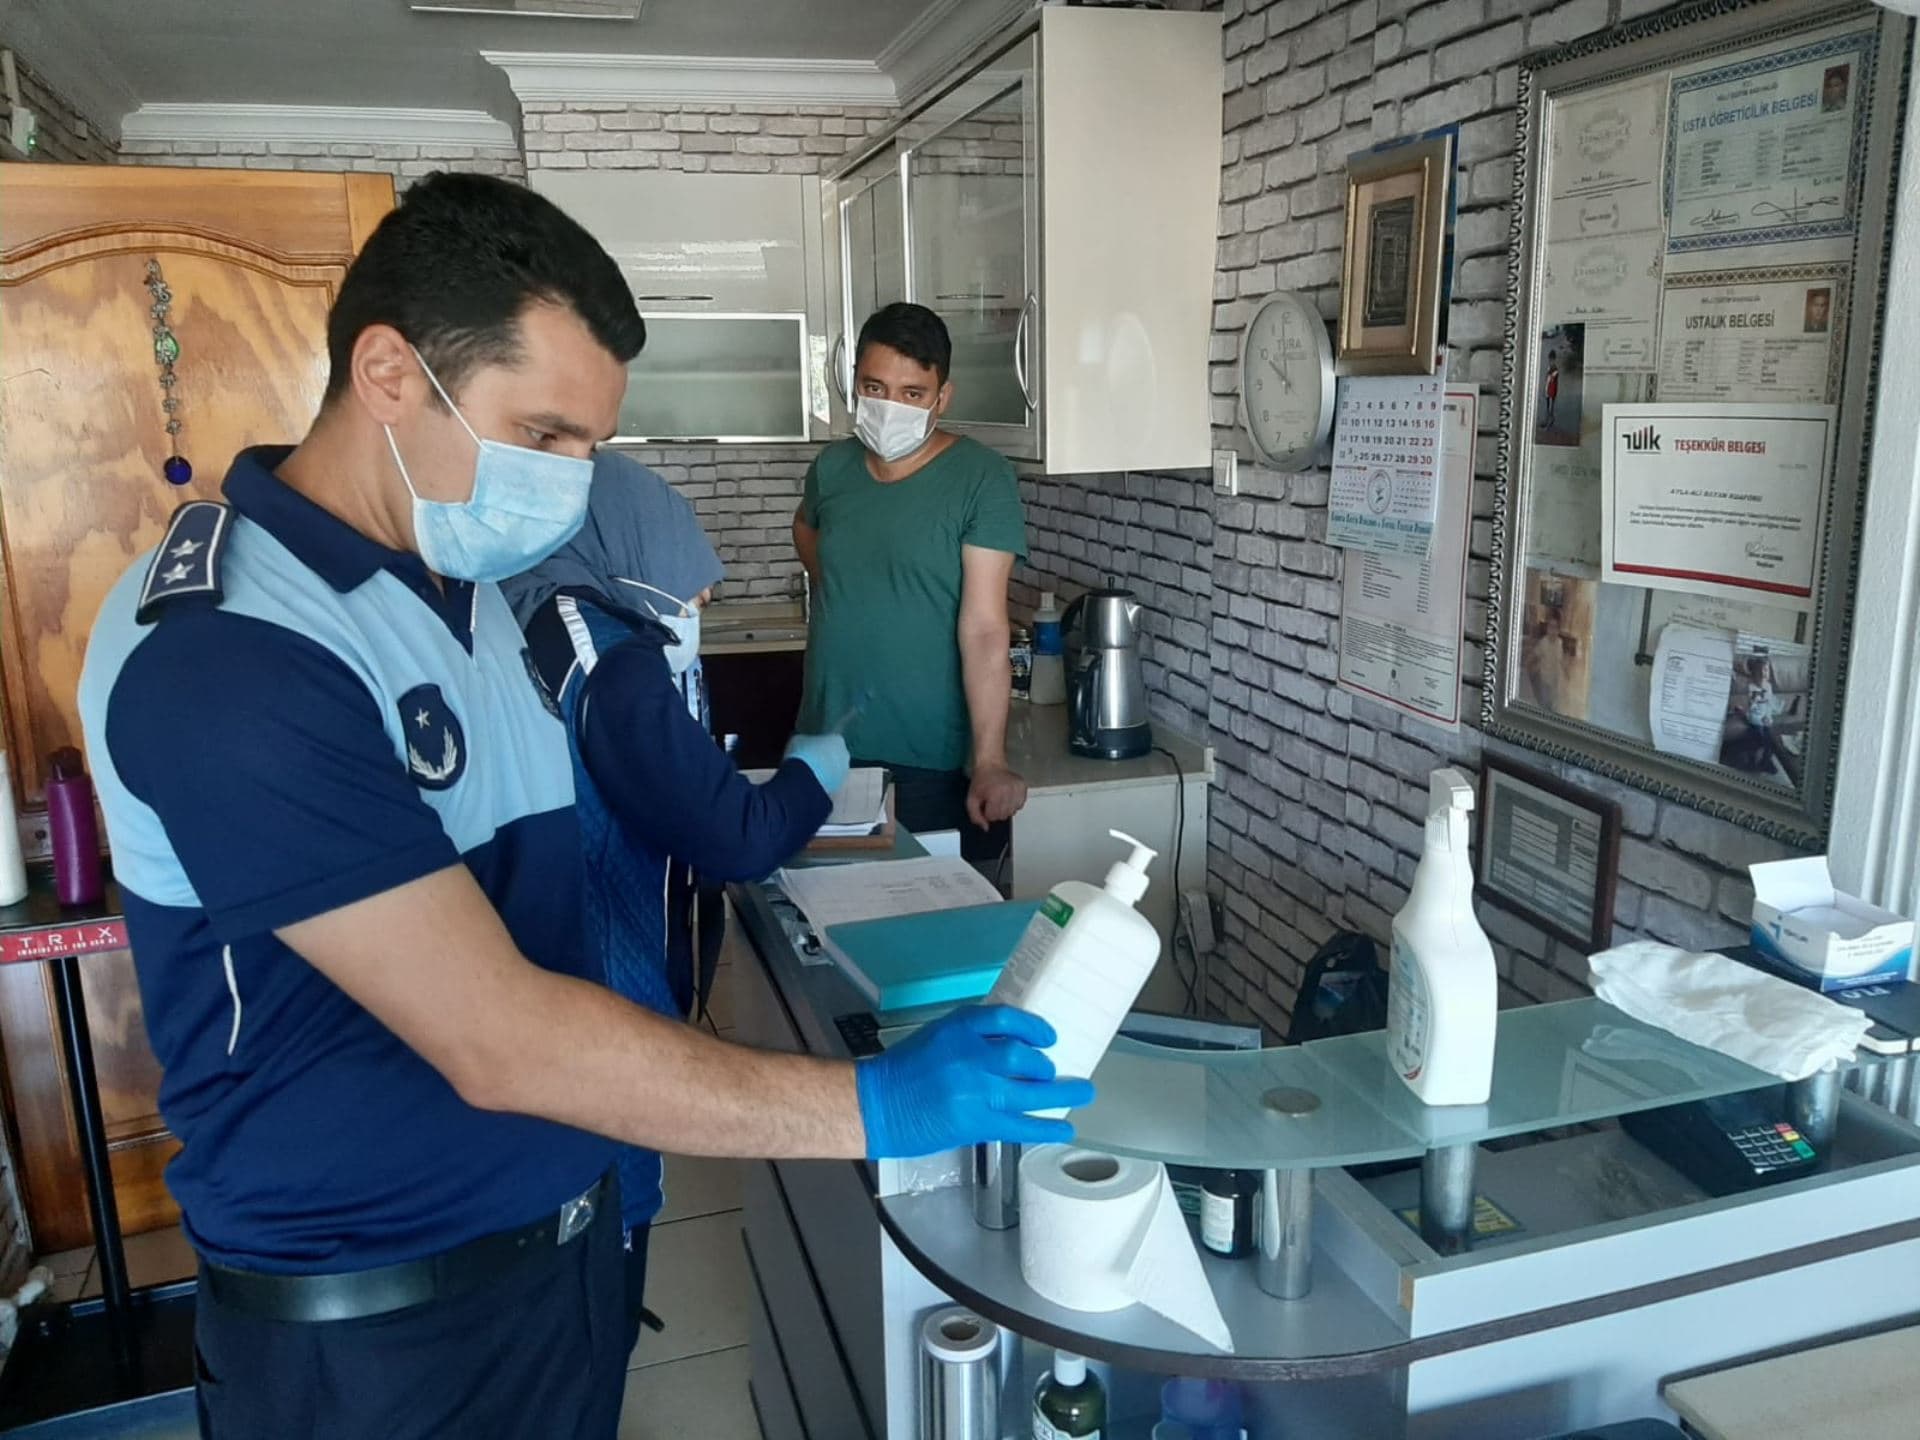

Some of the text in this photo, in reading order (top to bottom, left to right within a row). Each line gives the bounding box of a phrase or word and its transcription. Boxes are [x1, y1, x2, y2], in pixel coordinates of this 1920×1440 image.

[1683, 116, 1707, 133] USTA
[1772, 89, 1818, 115] BELGESİ
[1729, 309, 1775, 328] BELGESİ
[1727, 440, 1766, 454] BELGESİ
